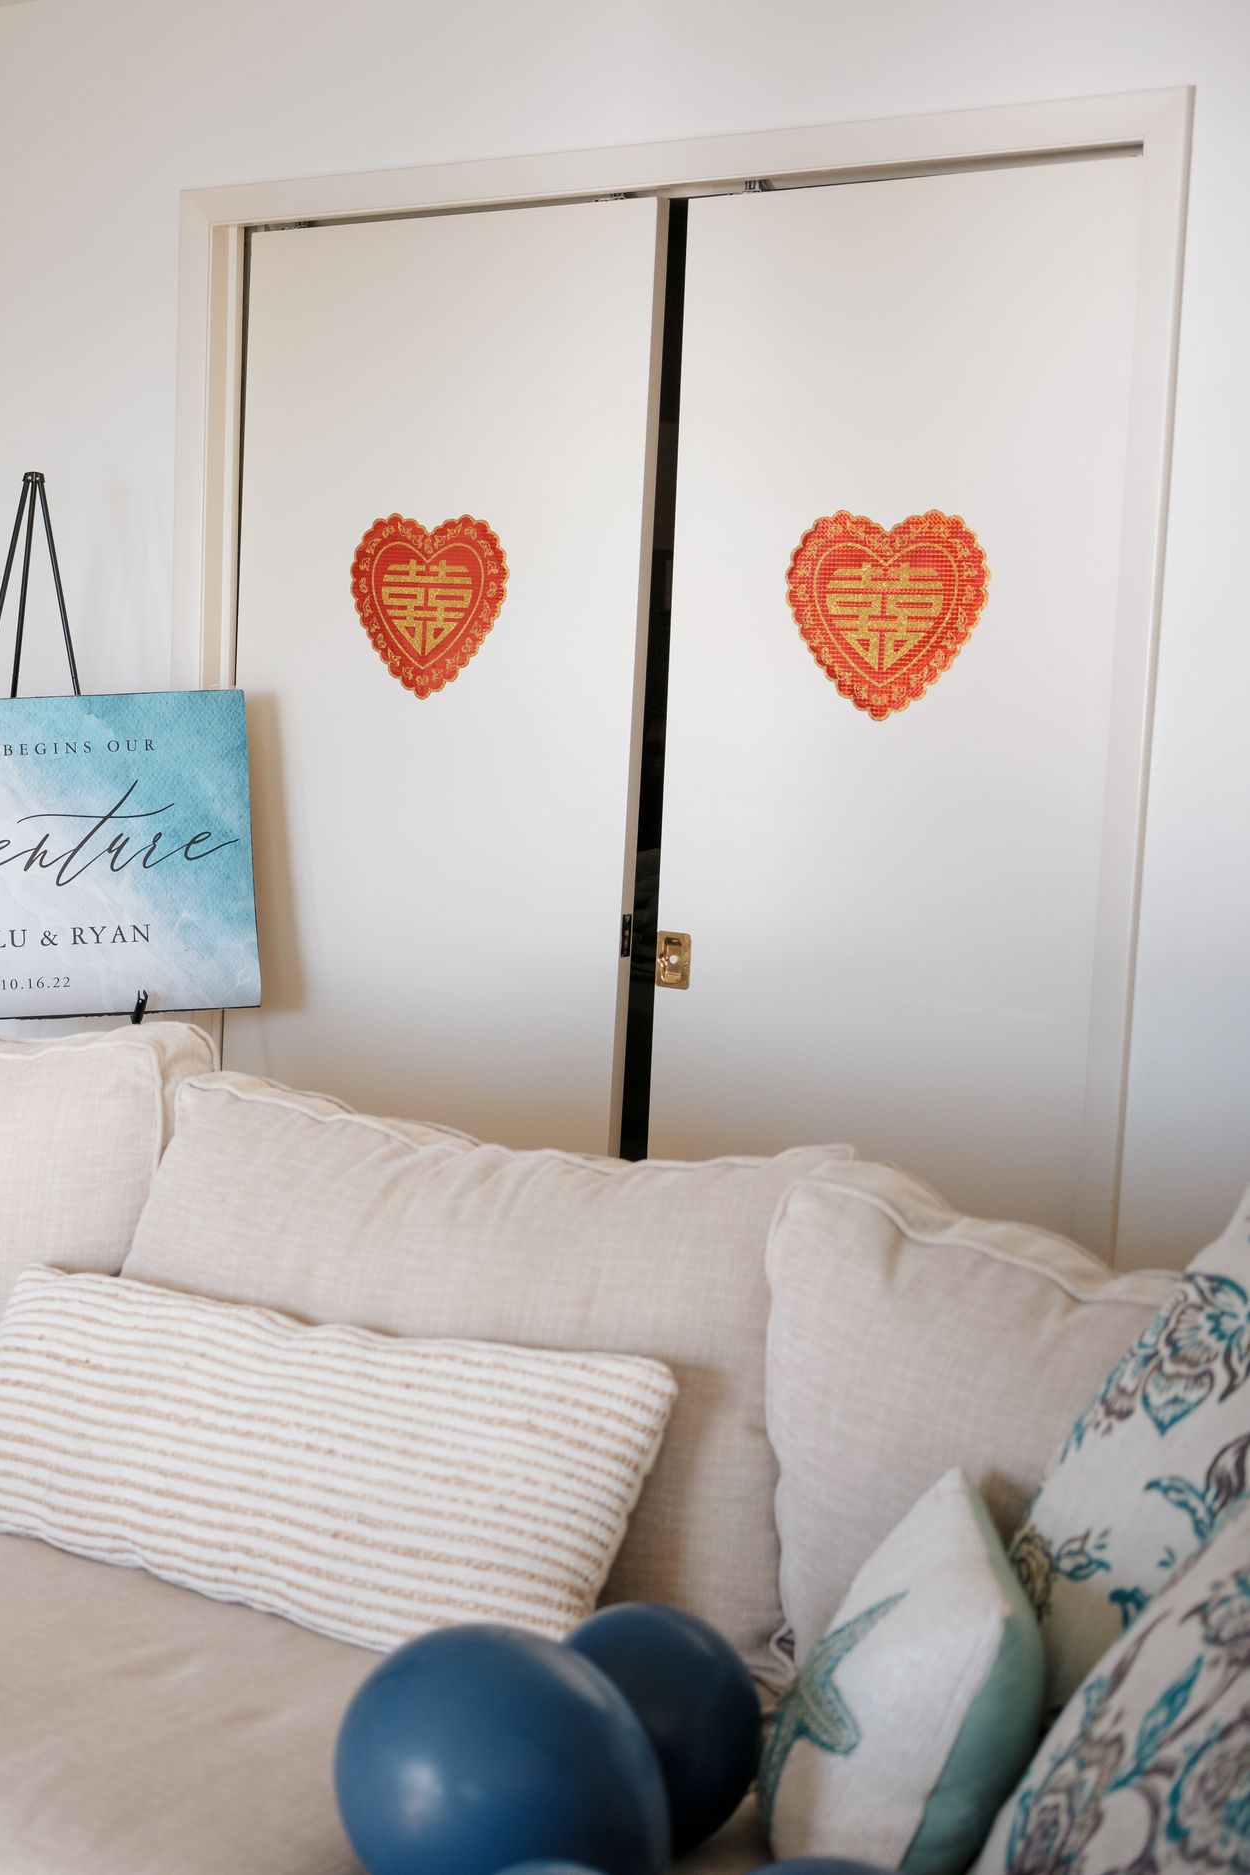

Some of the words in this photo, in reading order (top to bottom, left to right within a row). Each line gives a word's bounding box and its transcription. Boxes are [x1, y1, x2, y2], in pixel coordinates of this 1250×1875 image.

[3, 739, 93, 756] BEGINS
[107, 738, 157, 753] OUR
[40, 929, 60, 947] &
[71, 923, 152, 945] RYAN
[1, 976, 71, 991] 10.16.22
